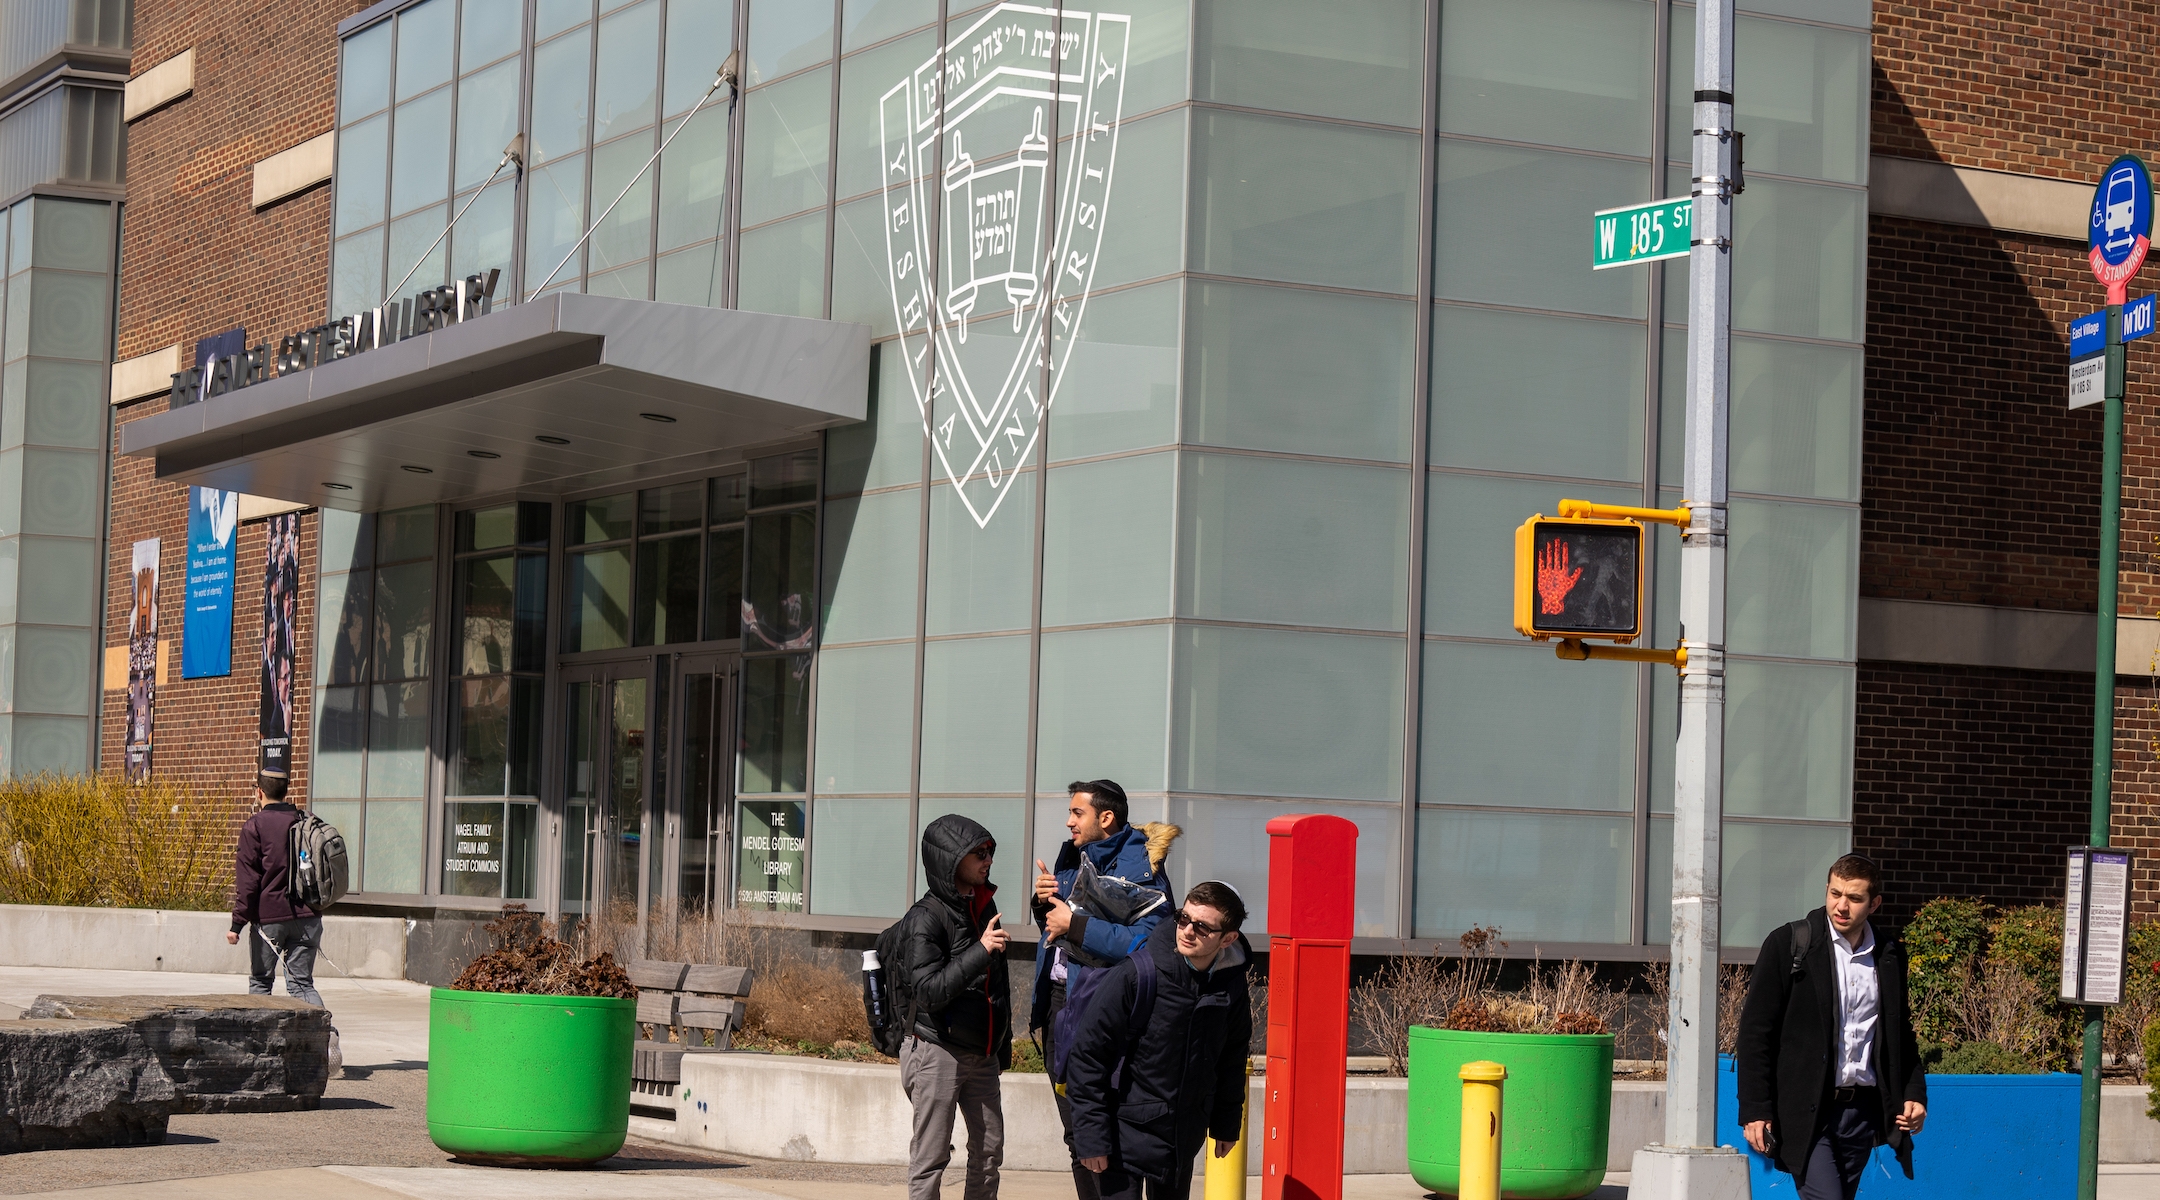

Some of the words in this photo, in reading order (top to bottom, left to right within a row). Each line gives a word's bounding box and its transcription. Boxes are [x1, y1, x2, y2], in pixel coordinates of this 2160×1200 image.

[975, 189, 1015, 228] תורה
[974, 222, 1012, 261] ומדע
[1600, 217, 1617, 260] W
[1630, 210, 1664, 255] 185
[1673, 204, 1692, 228] ST
[983, 51, 1117, 489] UNIVERSITY
[2092, 253, 2104, 275] NO
[2104, 243, 2143, 281] STANDING
[400, 268, 501, 342] LIBRARY
[890, 142, 957, 450] YESHIVA
[2123, 300, 2151, 336] M101
[2072, 324, 2083, 340] East
[2083, 322, 2099, 336] Village
[2071, 362, 2096, 380] Amsterdam
[2097, 360, 2104, 373] Av
[2071, 382, 2077, 396] W
[2077, 380, 2086, 394] 185
[2086, 379, 2092, 392] St
[770, 812, 785, 827] THE
[455, 823, 473, 836] NAGEL
[473, 823, 492, 836] FAMILY
[456, 841, 477, 854] ATRIUM
[477, 842, 489, 854] AND
[742, 836, 771, 850] MENDEL
[771, 836, 805, 851] GOTTESM
[445, 858, 470, 872] STUDENT
[470, 859, 499, 873] COMMONS
[763, 861, 792, 876] LIBRARY
[753, 890, 791, 904] AMSTERDAM
[791, 891, 803, 905] AVE
